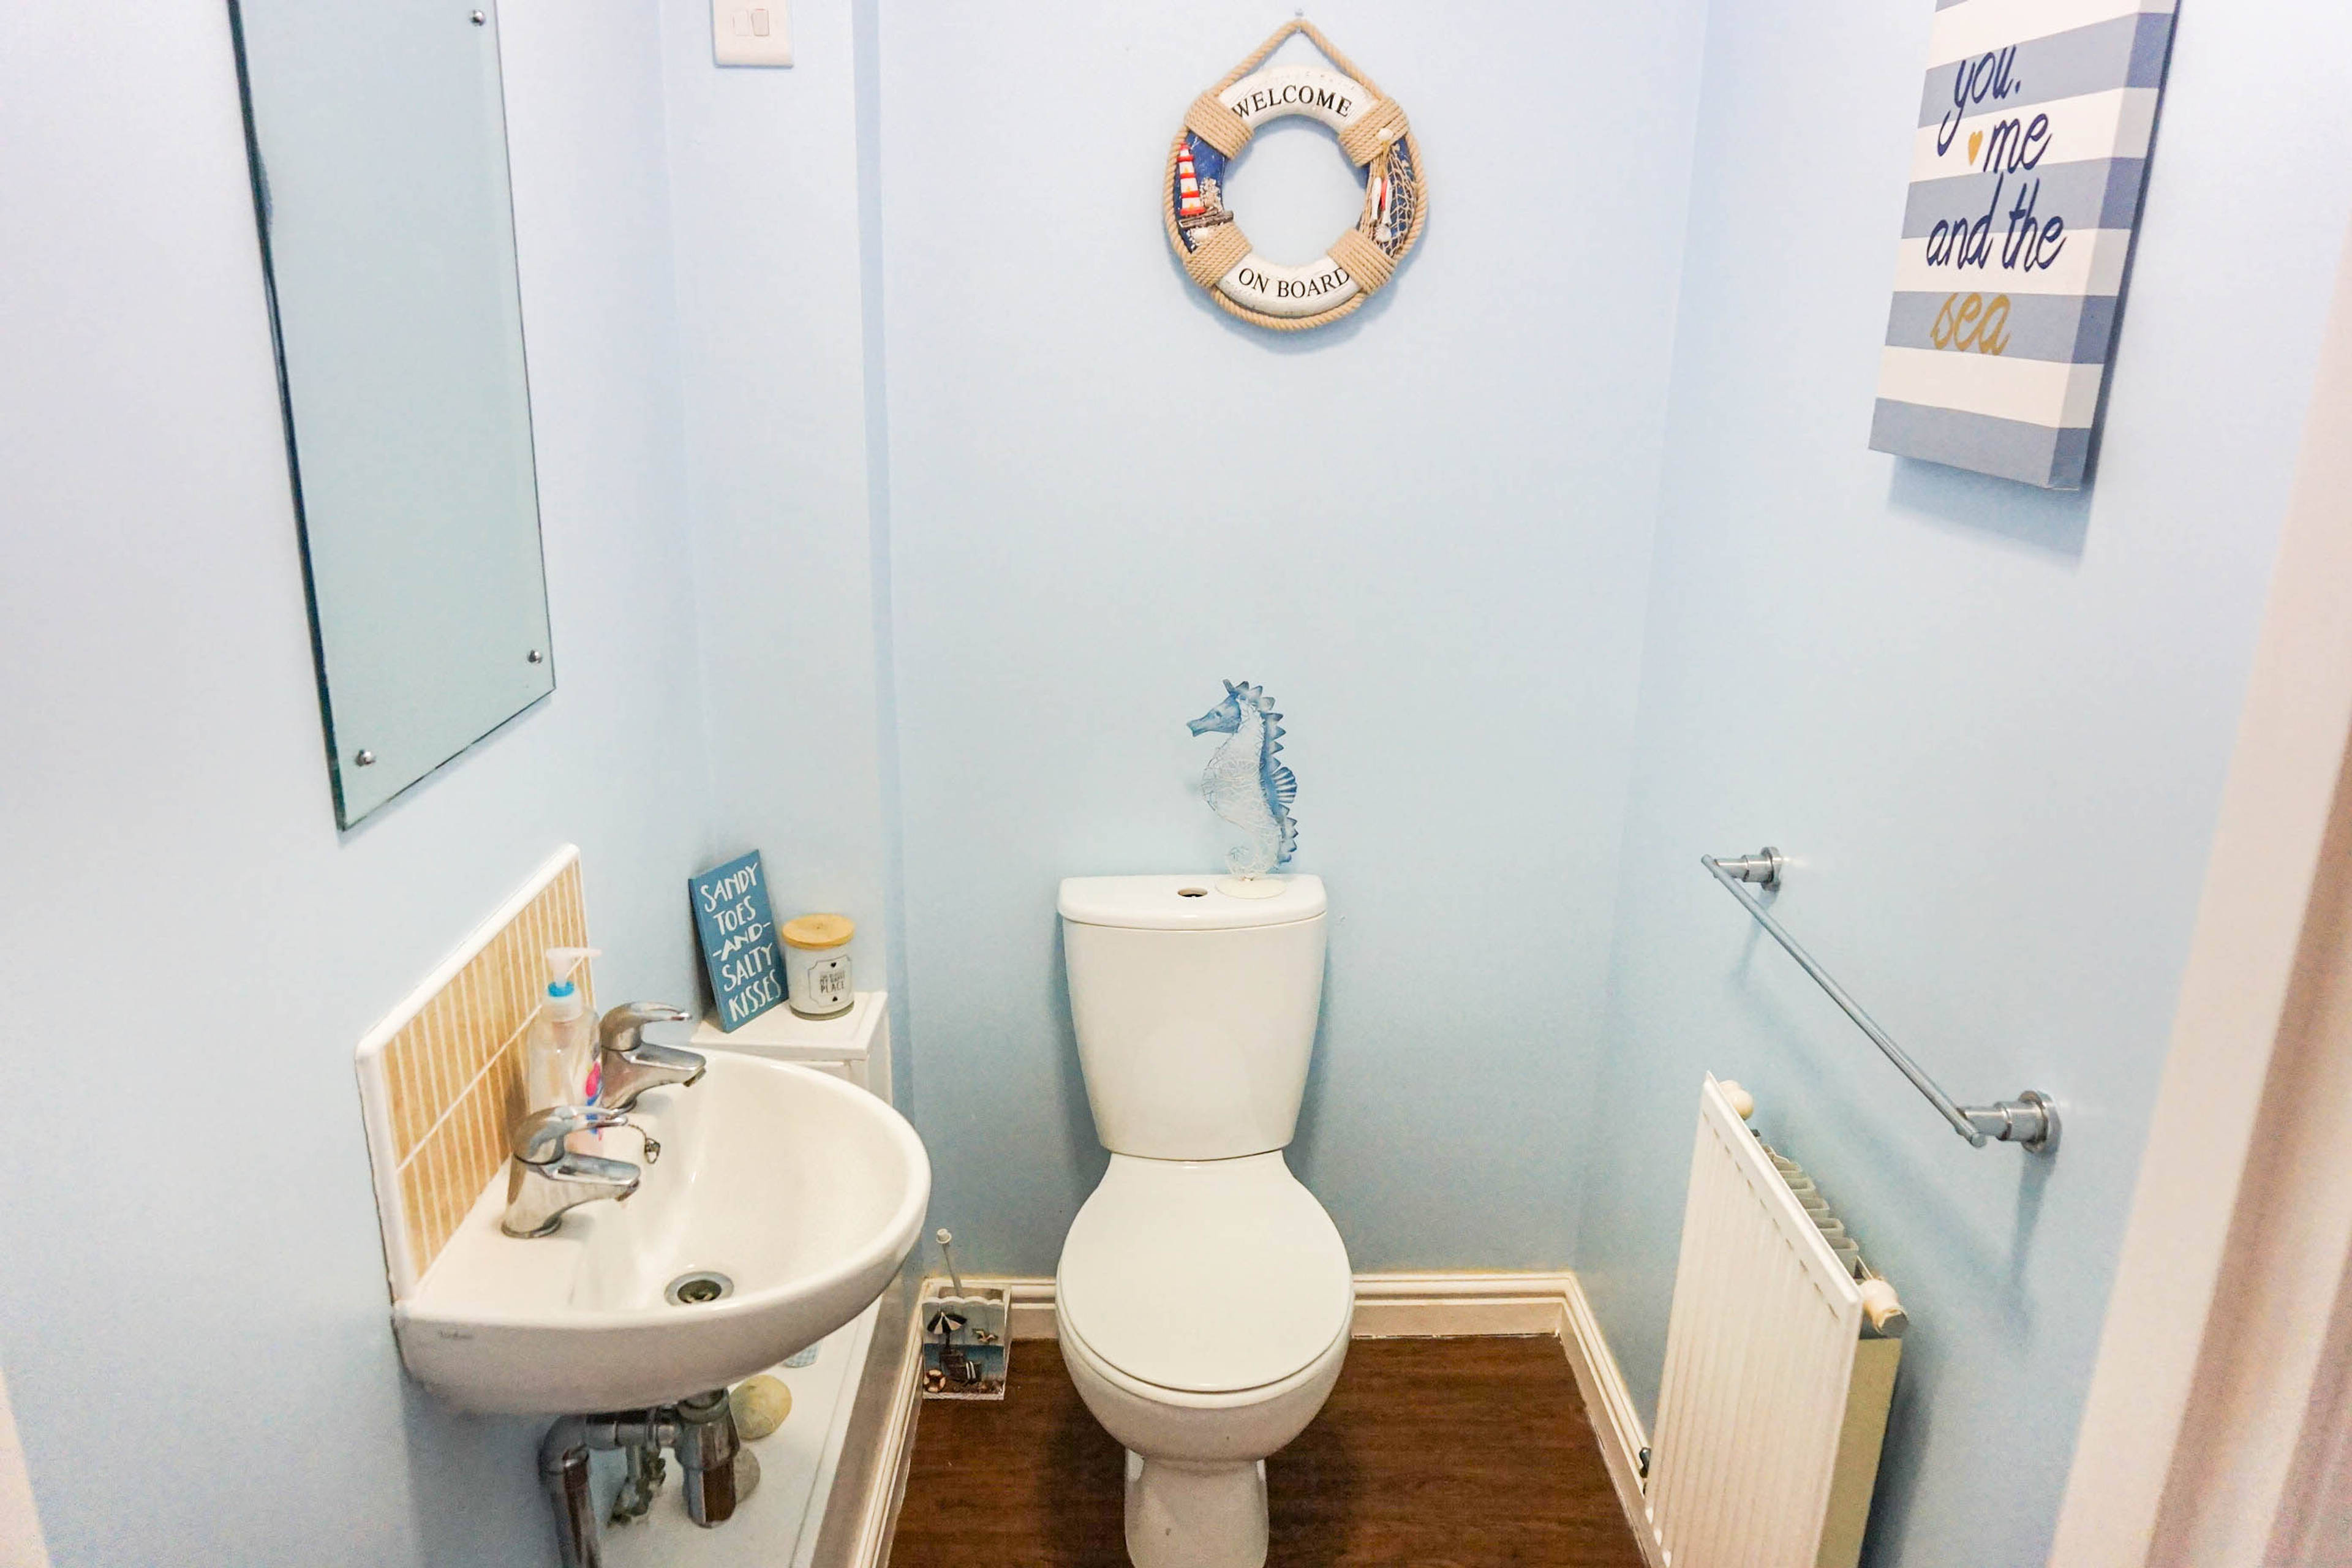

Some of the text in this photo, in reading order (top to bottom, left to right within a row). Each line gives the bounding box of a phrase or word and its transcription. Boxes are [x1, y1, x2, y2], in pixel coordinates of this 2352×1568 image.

[1231, 85, 1353, 119] WELCOME
[1983, 112, 2052, 175] me
[1926, 171, 2067, 273] and the
[1238, 266, 1350, 299] ON BOARD
[1929, 292, 2011, 356] sea
[699, 862, 758, 913] SANDY
[712, 895, 756, 936] TOES
[722, 942, 773, 992] SALTY
[727, 968, 782, 1022] KISSES
